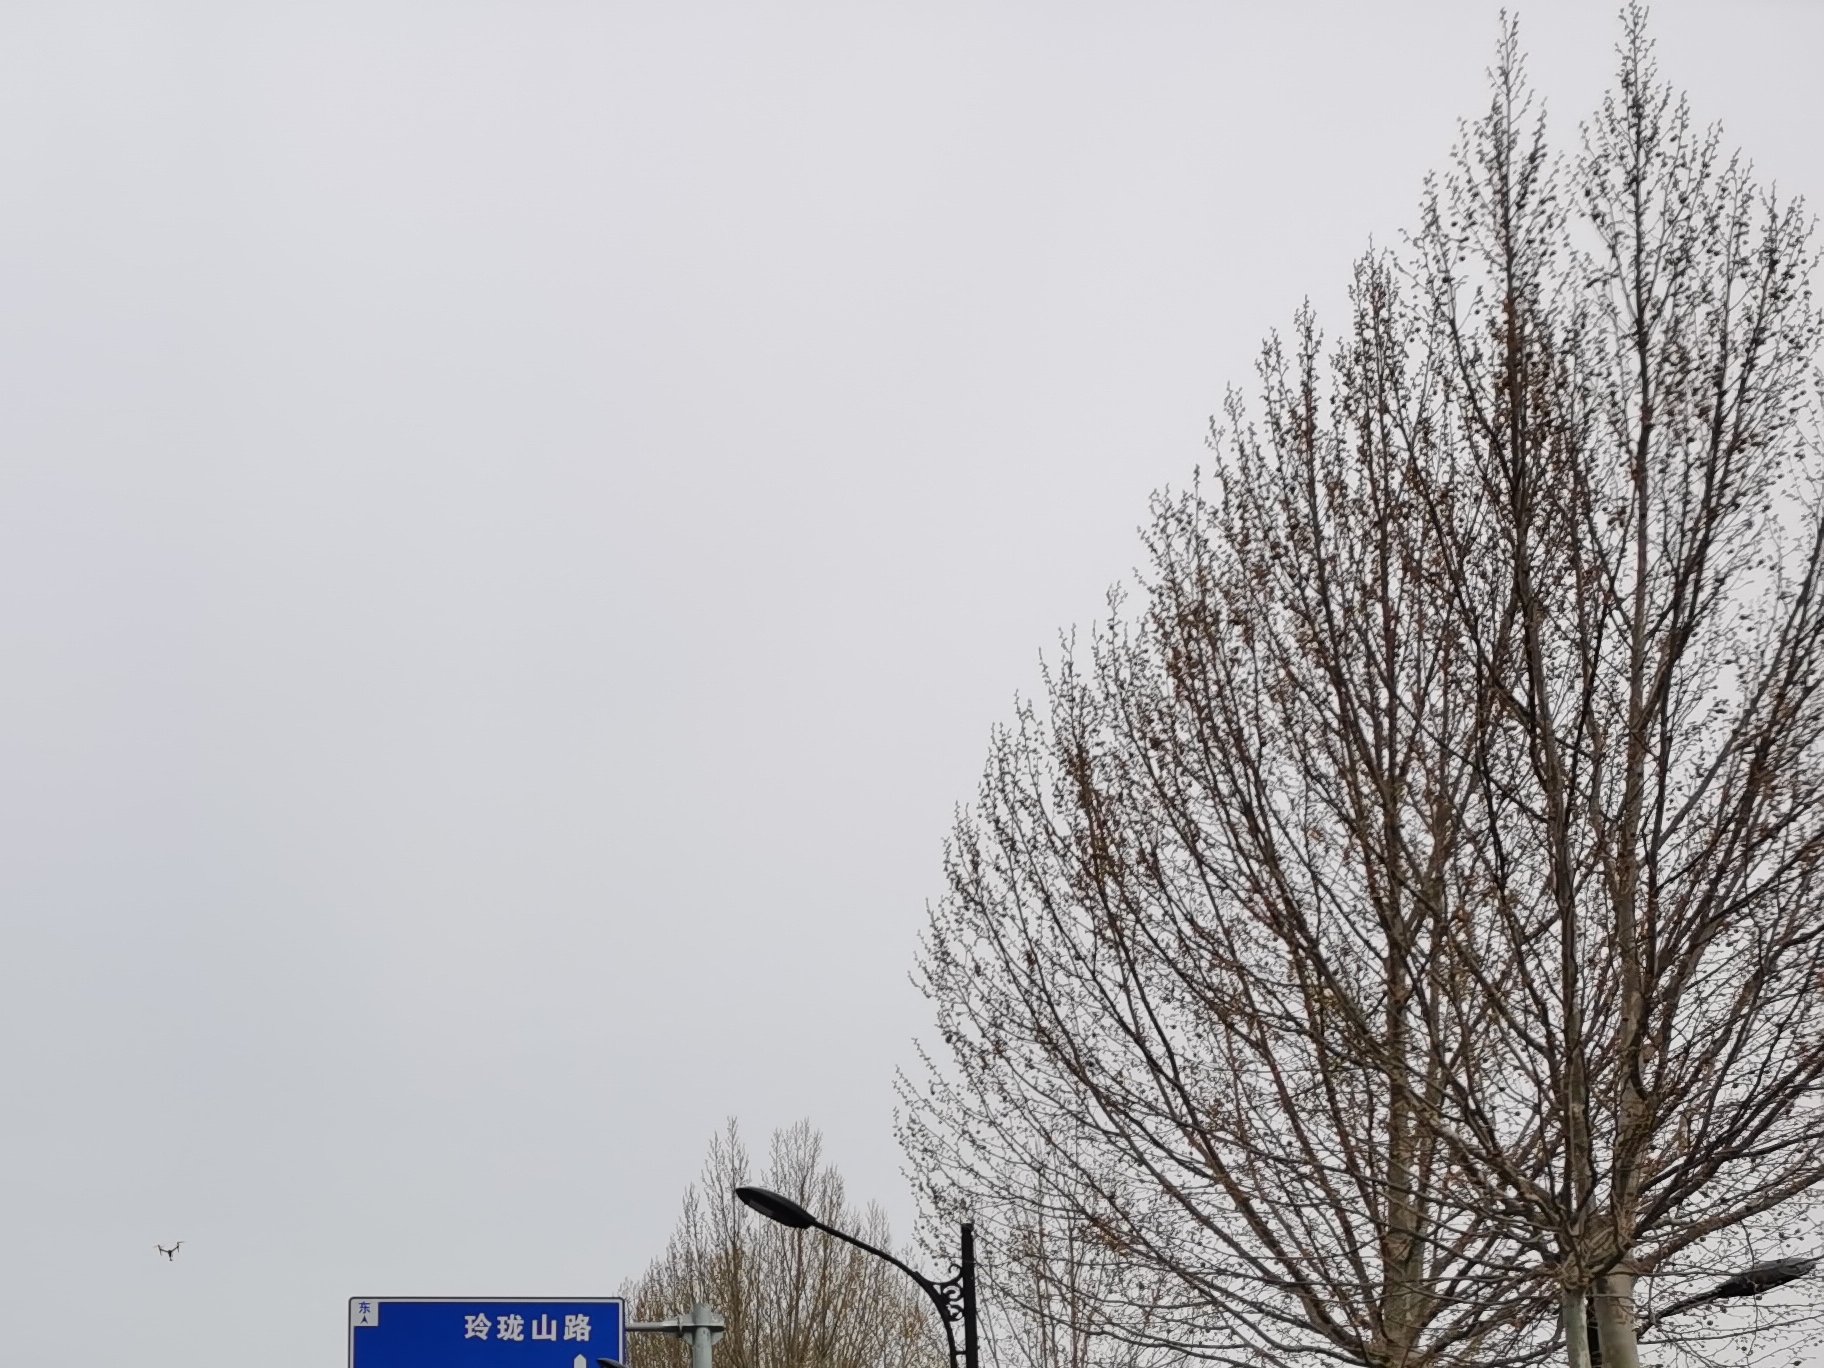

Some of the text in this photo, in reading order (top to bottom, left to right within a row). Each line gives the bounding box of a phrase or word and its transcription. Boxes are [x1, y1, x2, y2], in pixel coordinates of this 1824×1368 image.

[358, 1301, 371, 1314] 东
[464, 1313, 592, 1342] 玲珑山路
